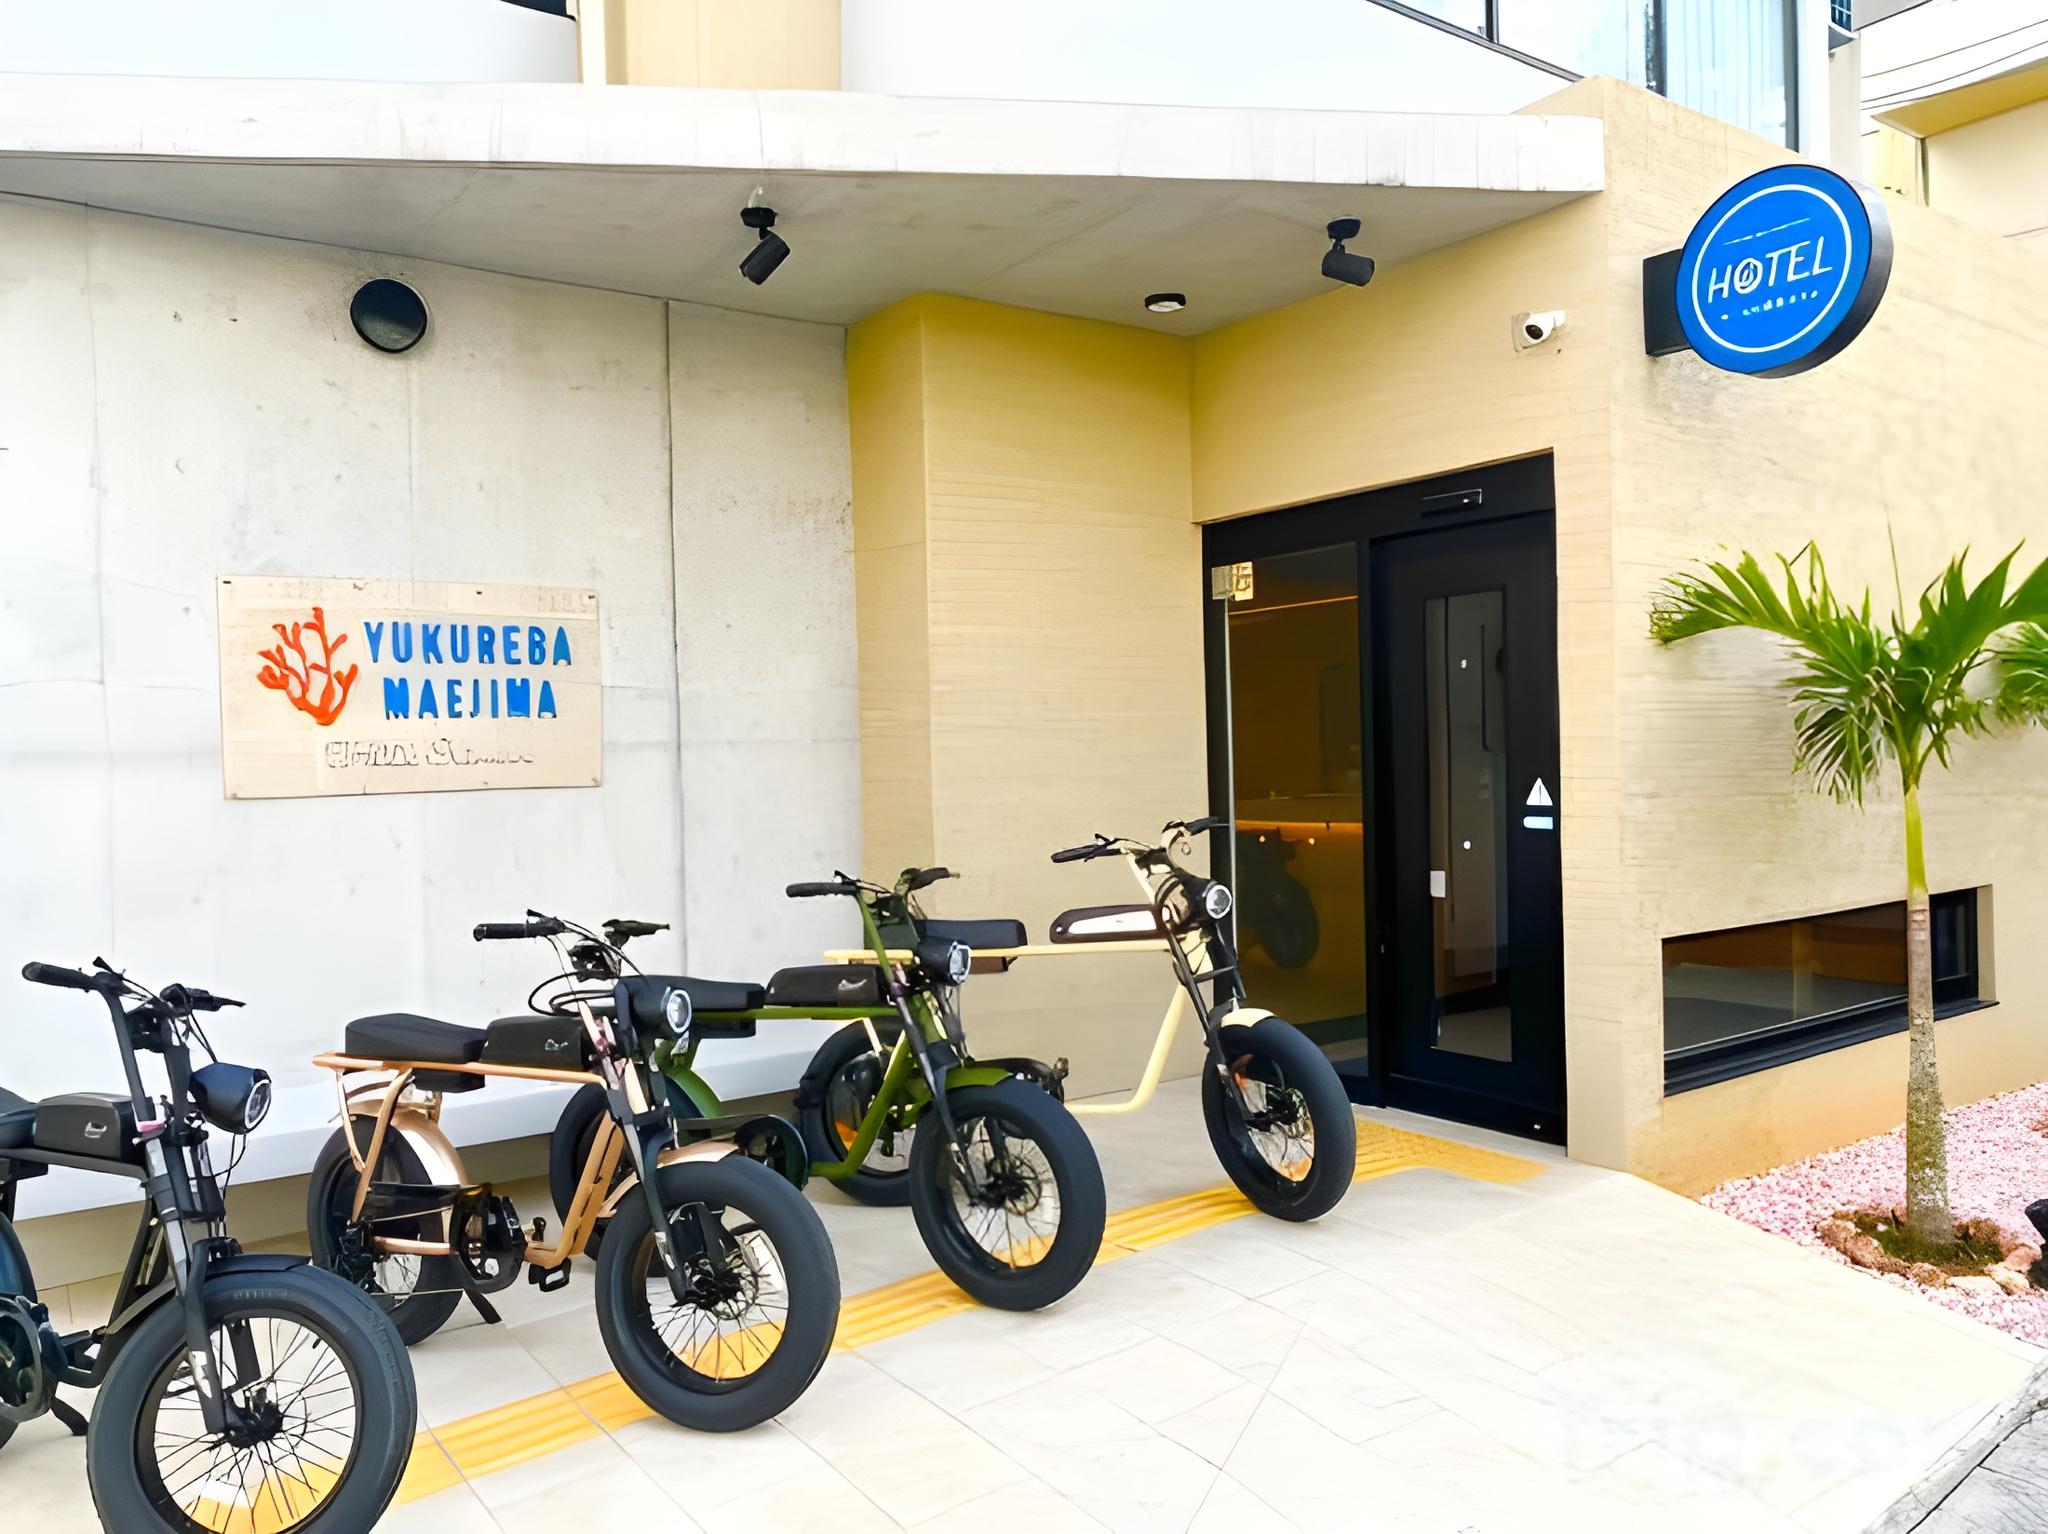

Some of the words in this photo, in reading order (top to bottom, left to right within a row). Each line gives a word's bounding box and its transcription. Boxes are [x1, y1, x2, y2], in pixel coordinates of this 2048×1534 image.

[1707, 235, 1833, 304] HOTEL
[363, 621, 572, 666] YUKUREBA
[383, 677, 557, 720] MAEJIMA
